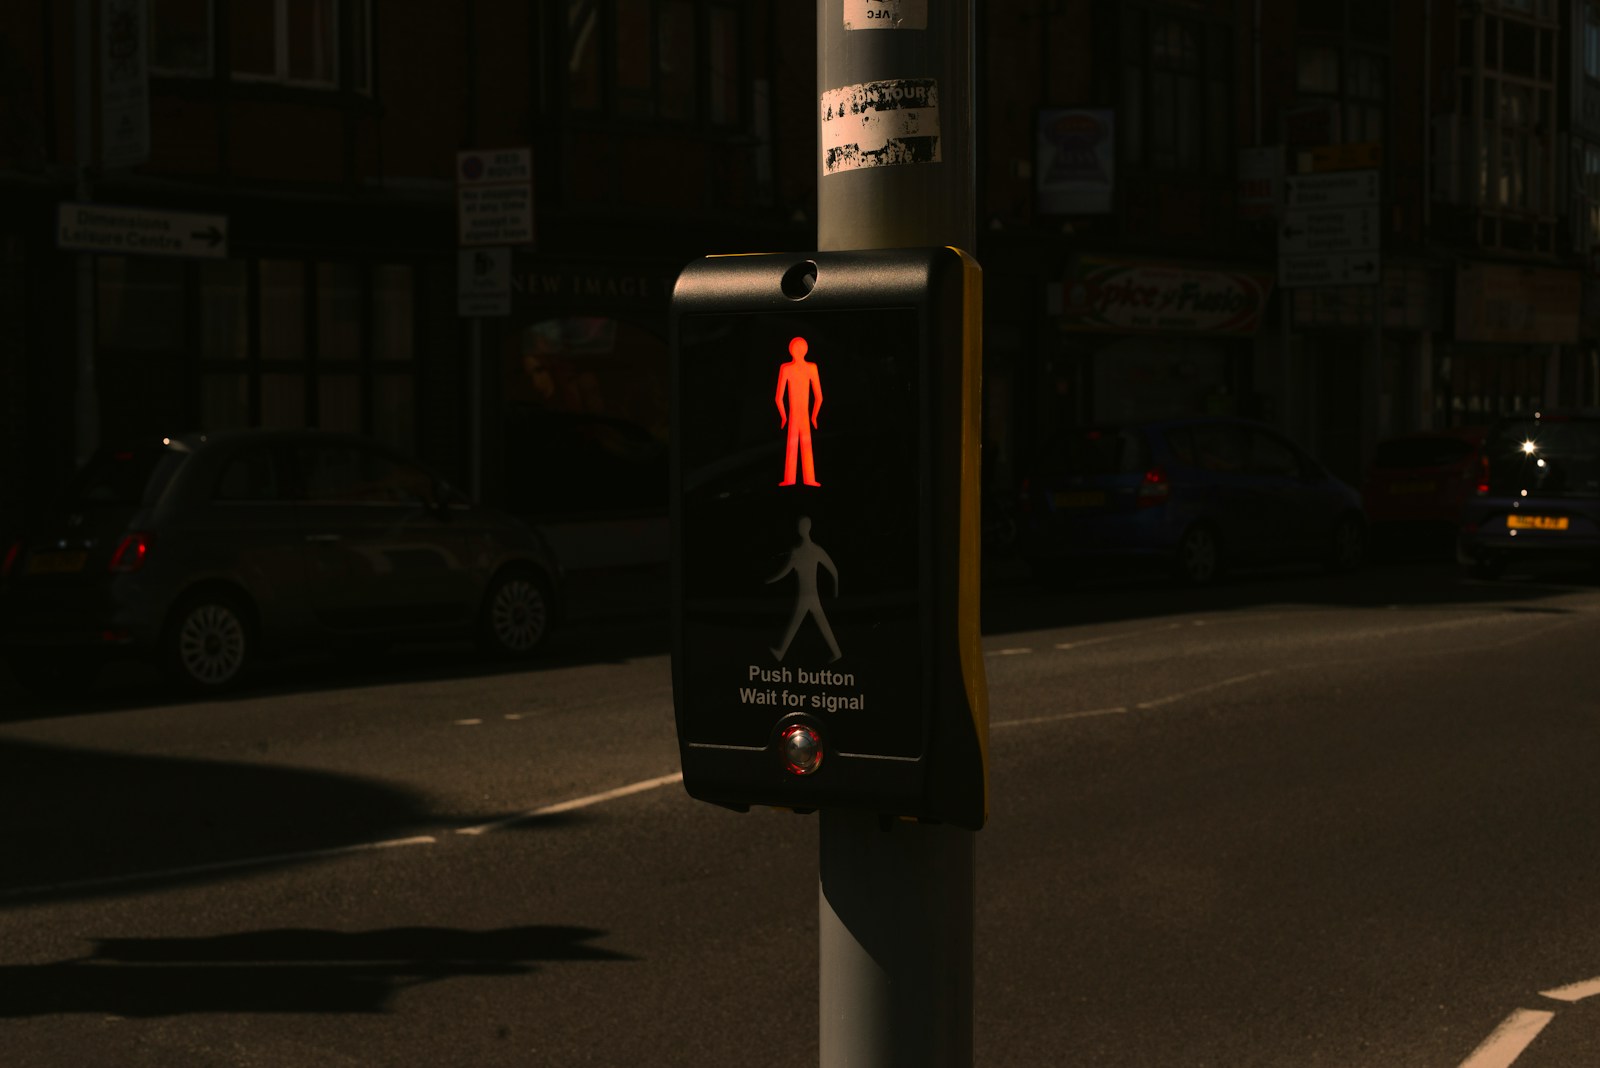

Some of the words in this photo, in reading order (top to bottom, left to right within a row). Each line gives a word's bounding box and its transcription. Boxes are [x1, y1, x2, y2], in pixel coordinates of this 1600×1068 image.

[881, 86, 926, 100] TOUR
[77, 209, 170, 231] Dimensions
[62, 226, 122, 245] Leisure
[126, 231, 183, 250] Centre
[511, 272, 561, 295] NEW
[572, 275, 649, 298] IMAGE
[748, 664, 793, 684] Push
[797, 667, 855, 687] button
[739, 687, 778, 706] Wait
[781, 689, 807, 707] for
[811, 691, 865, 713] signal
